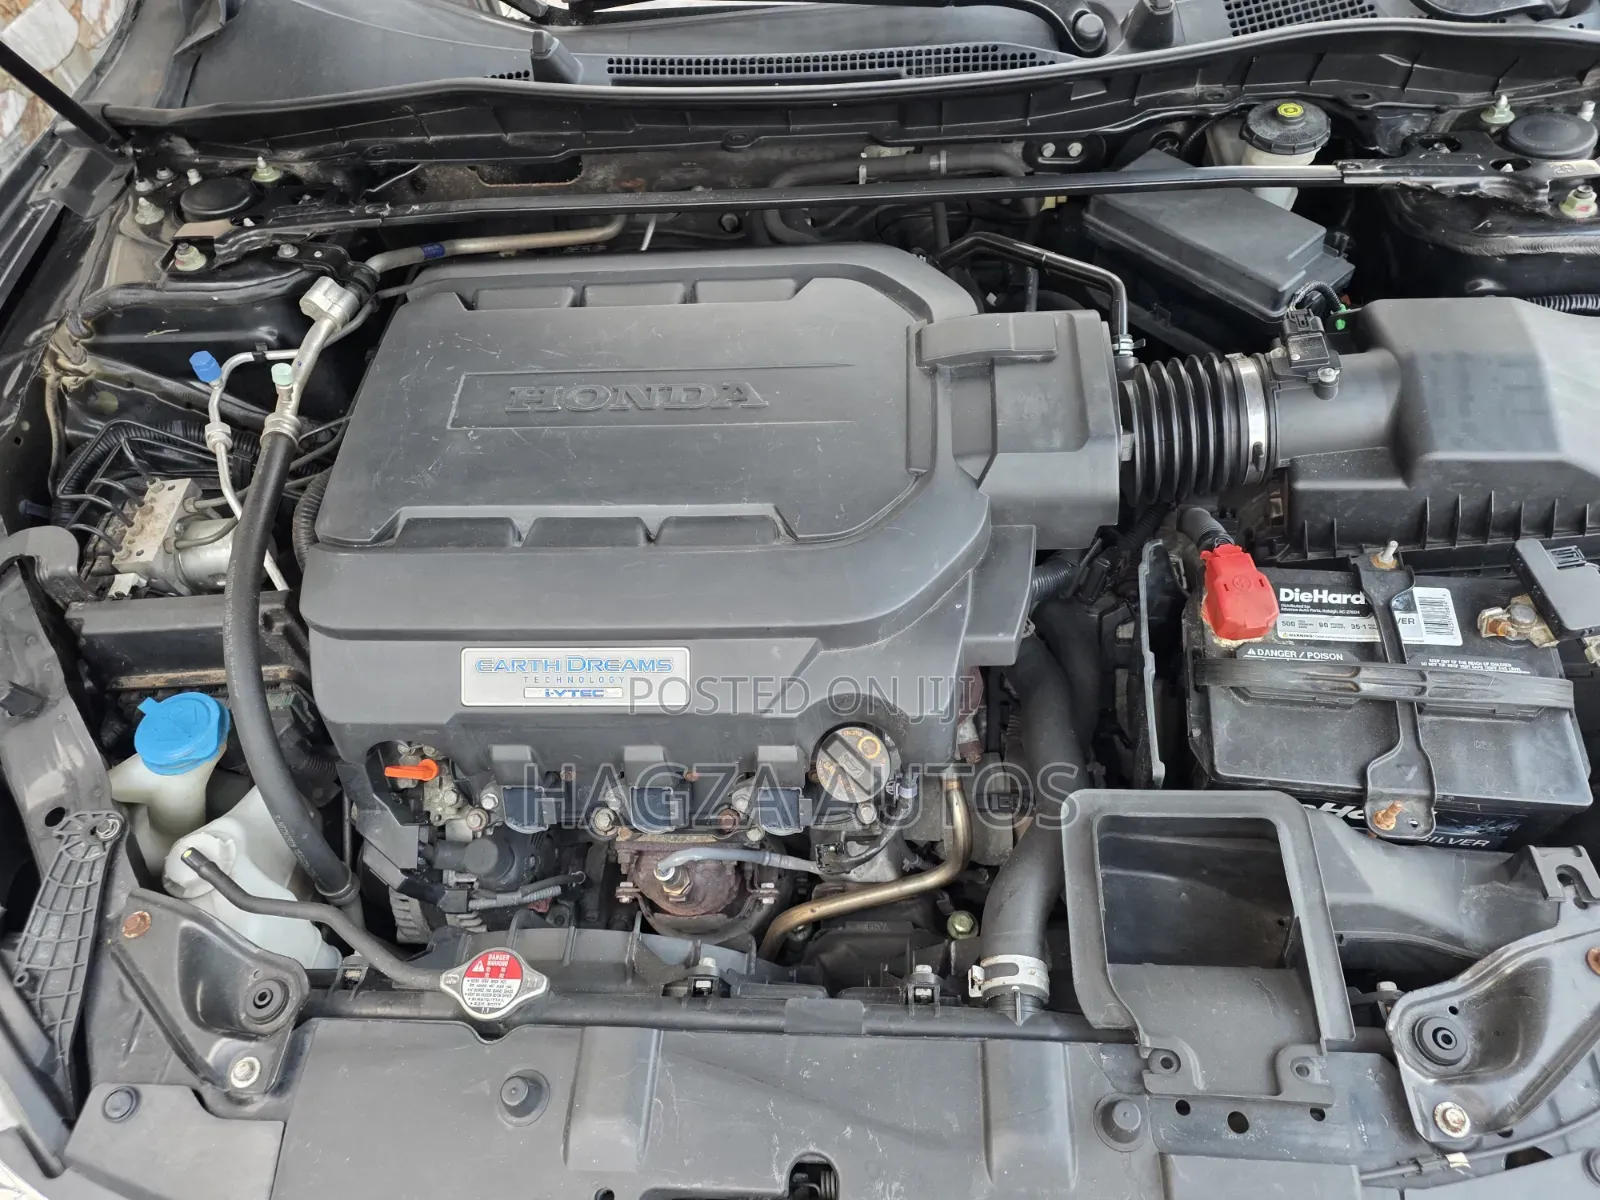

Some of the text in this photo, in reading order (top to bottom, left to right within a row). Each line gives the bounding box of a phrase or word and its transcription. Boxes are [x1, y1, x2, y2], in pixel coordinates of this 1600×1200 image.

[505, 381, 769, 412] HONDA
[1280, 588, 1366, 605] DieHard
[1257, 648, 1298, 658] DANGER
[1306, 651, 1344, 661] POISON
[474, 655, 674, 674] EARTH DREAMS
[523, 676, 626, 685] TECHNOLOGY
[544, 688, 606, 698] i-VTEC
